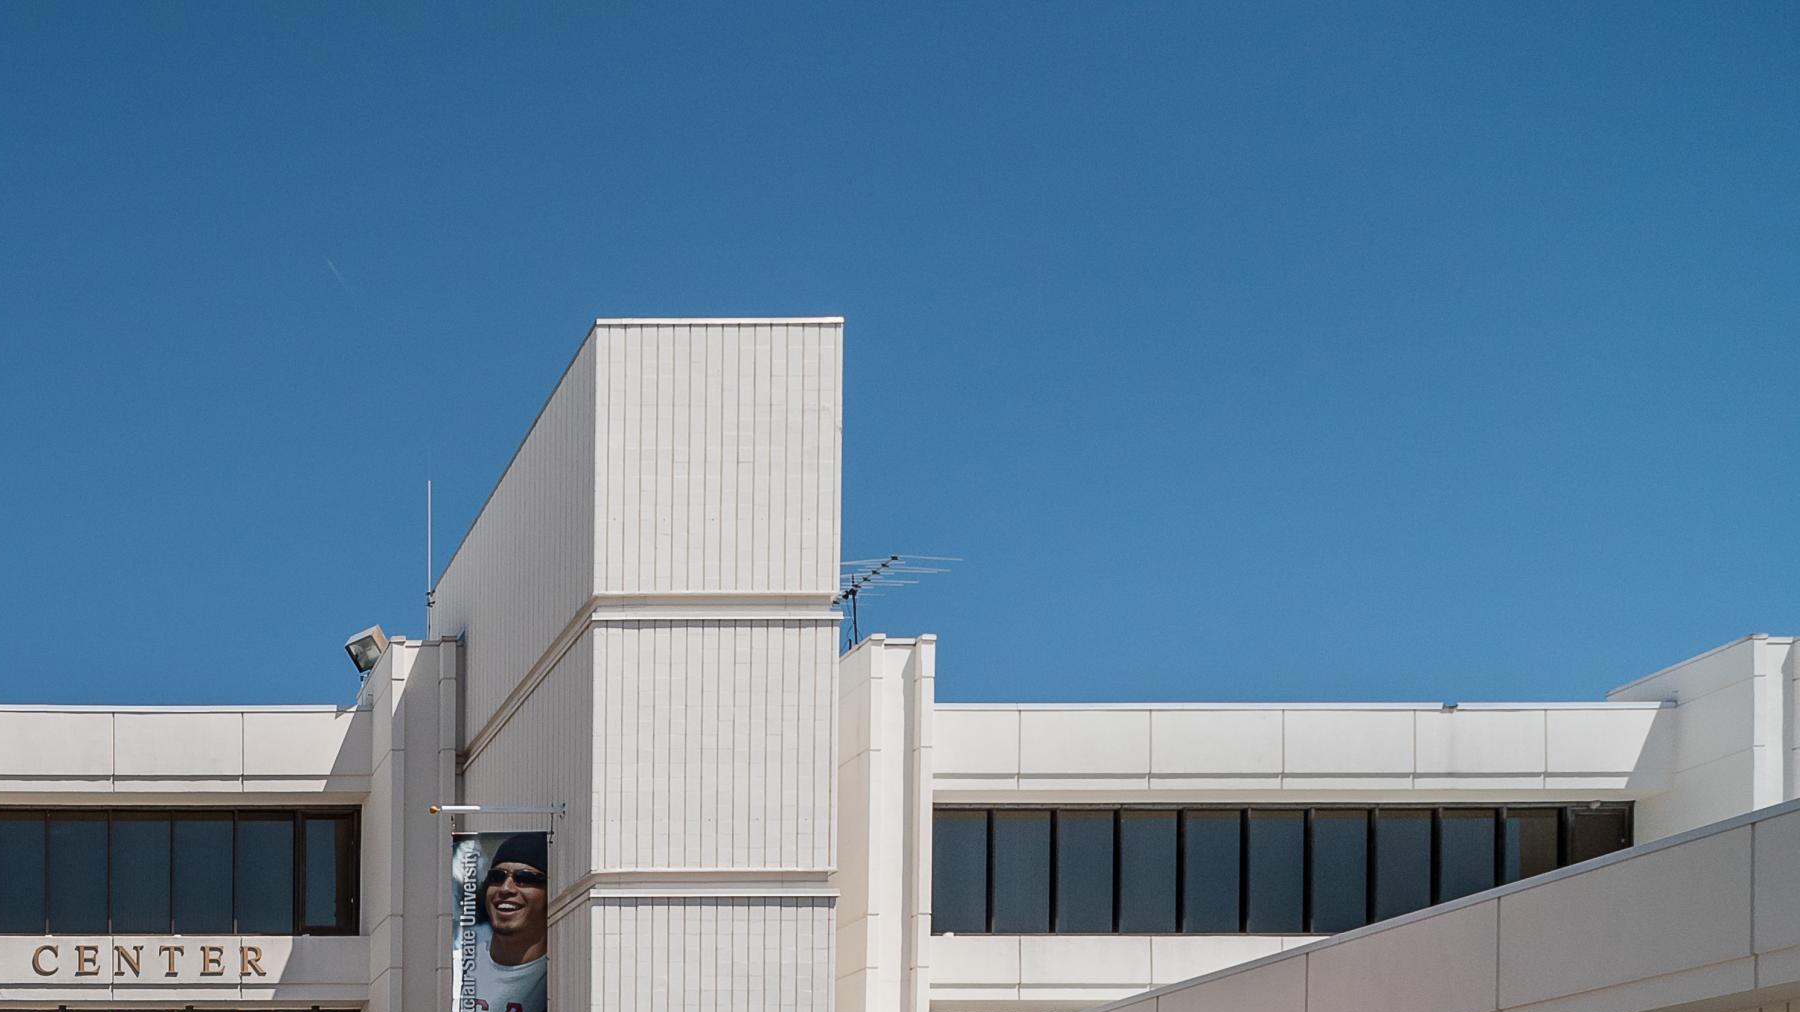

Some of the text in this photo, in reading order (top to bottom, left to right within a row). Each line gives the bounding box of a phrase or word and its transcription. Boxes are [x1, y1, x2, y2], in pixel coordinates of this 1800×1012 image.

[459, 846, 481, 928] University
[31, 944, 268, 978] CENTER
[461, 930, 477, 972] State
